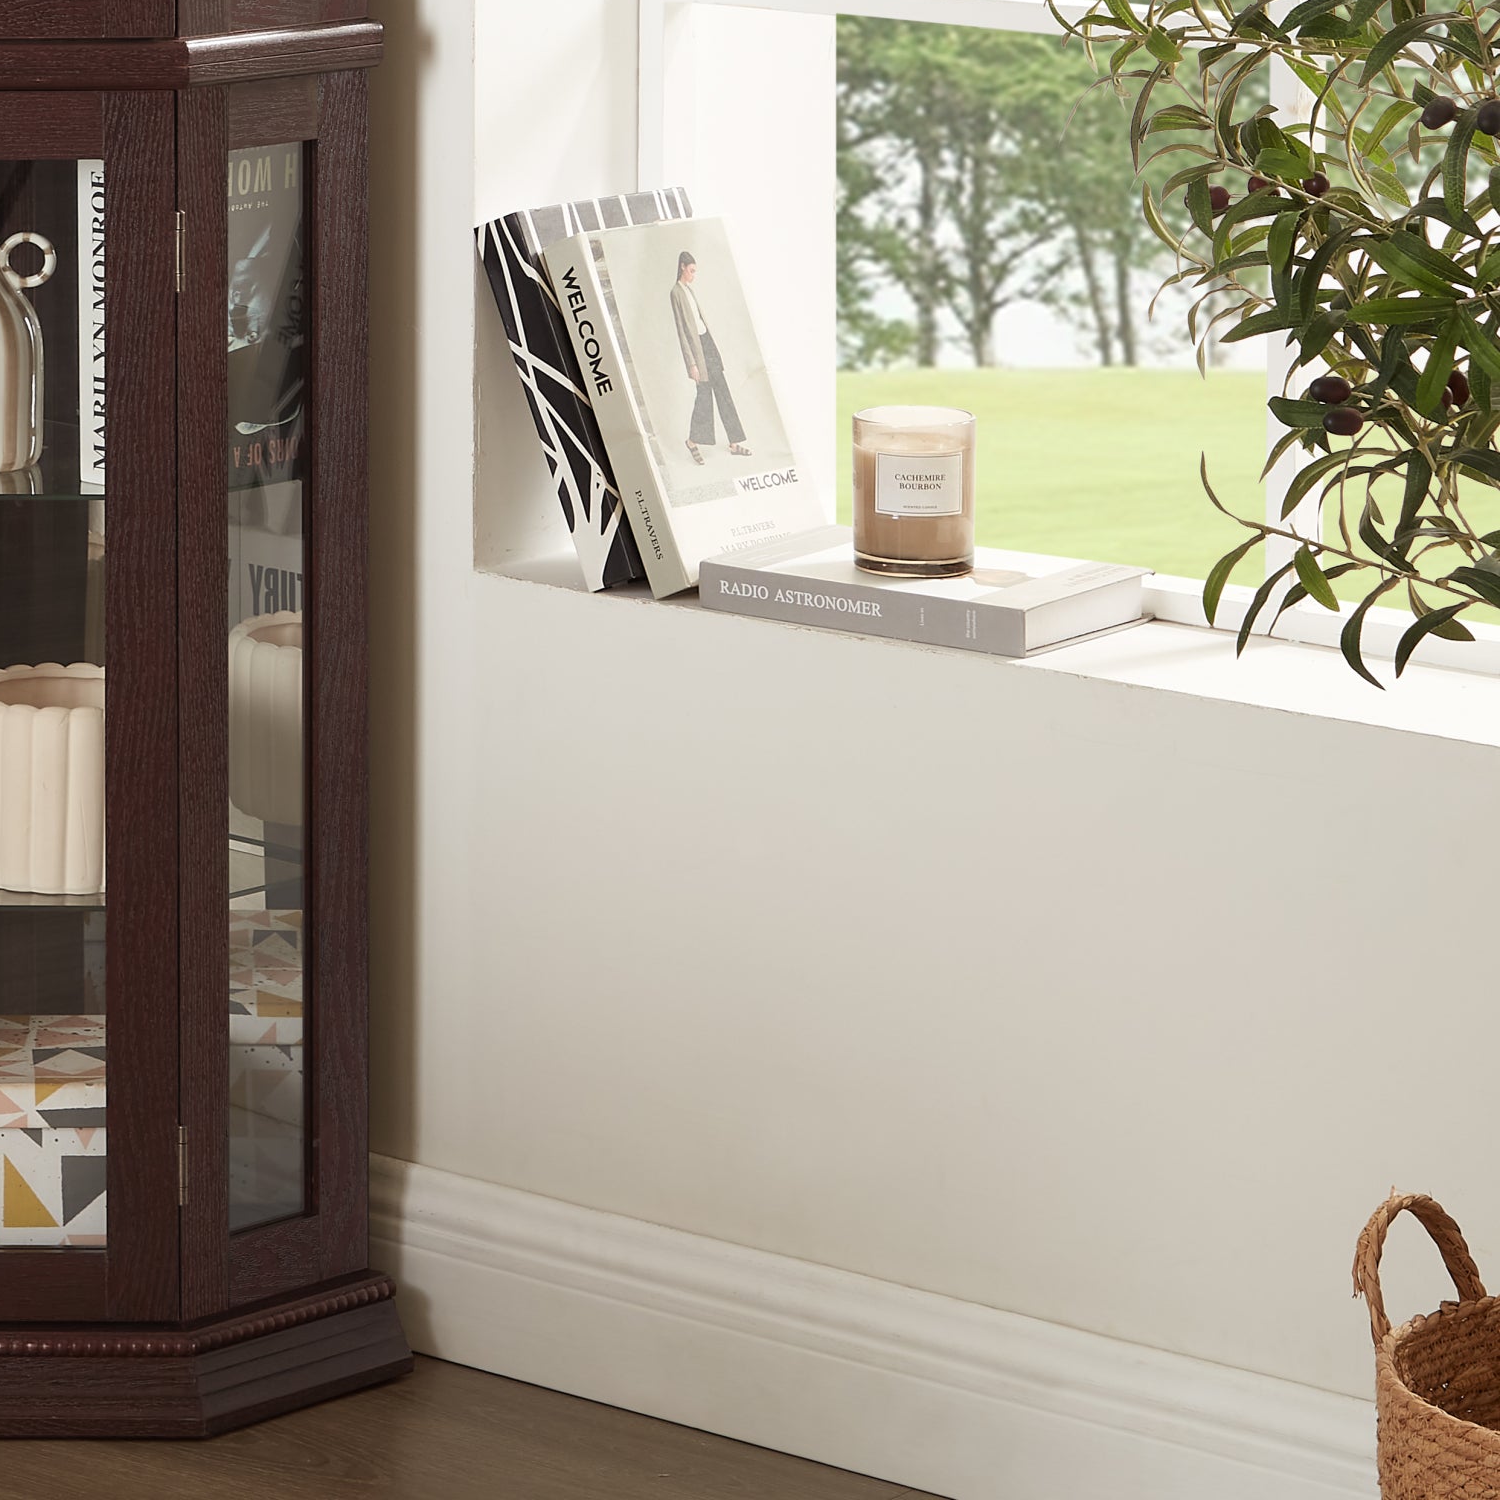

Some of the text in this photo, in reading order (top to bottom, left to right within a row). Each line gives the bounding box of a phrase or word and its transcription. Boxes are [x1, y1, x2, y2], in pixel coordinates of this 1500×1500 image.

[91, 171, 106, 470] MARILYN MONROE
[561, 266, 613, 397] WELCOME
[738, 469, 799, 491] WELCOME
[894, 473, 946, 482] CACHEMIRE
[899, 482, 942, 490] BOURBON
[719, 579, 882, 617] RADIO ASTRONOMER
